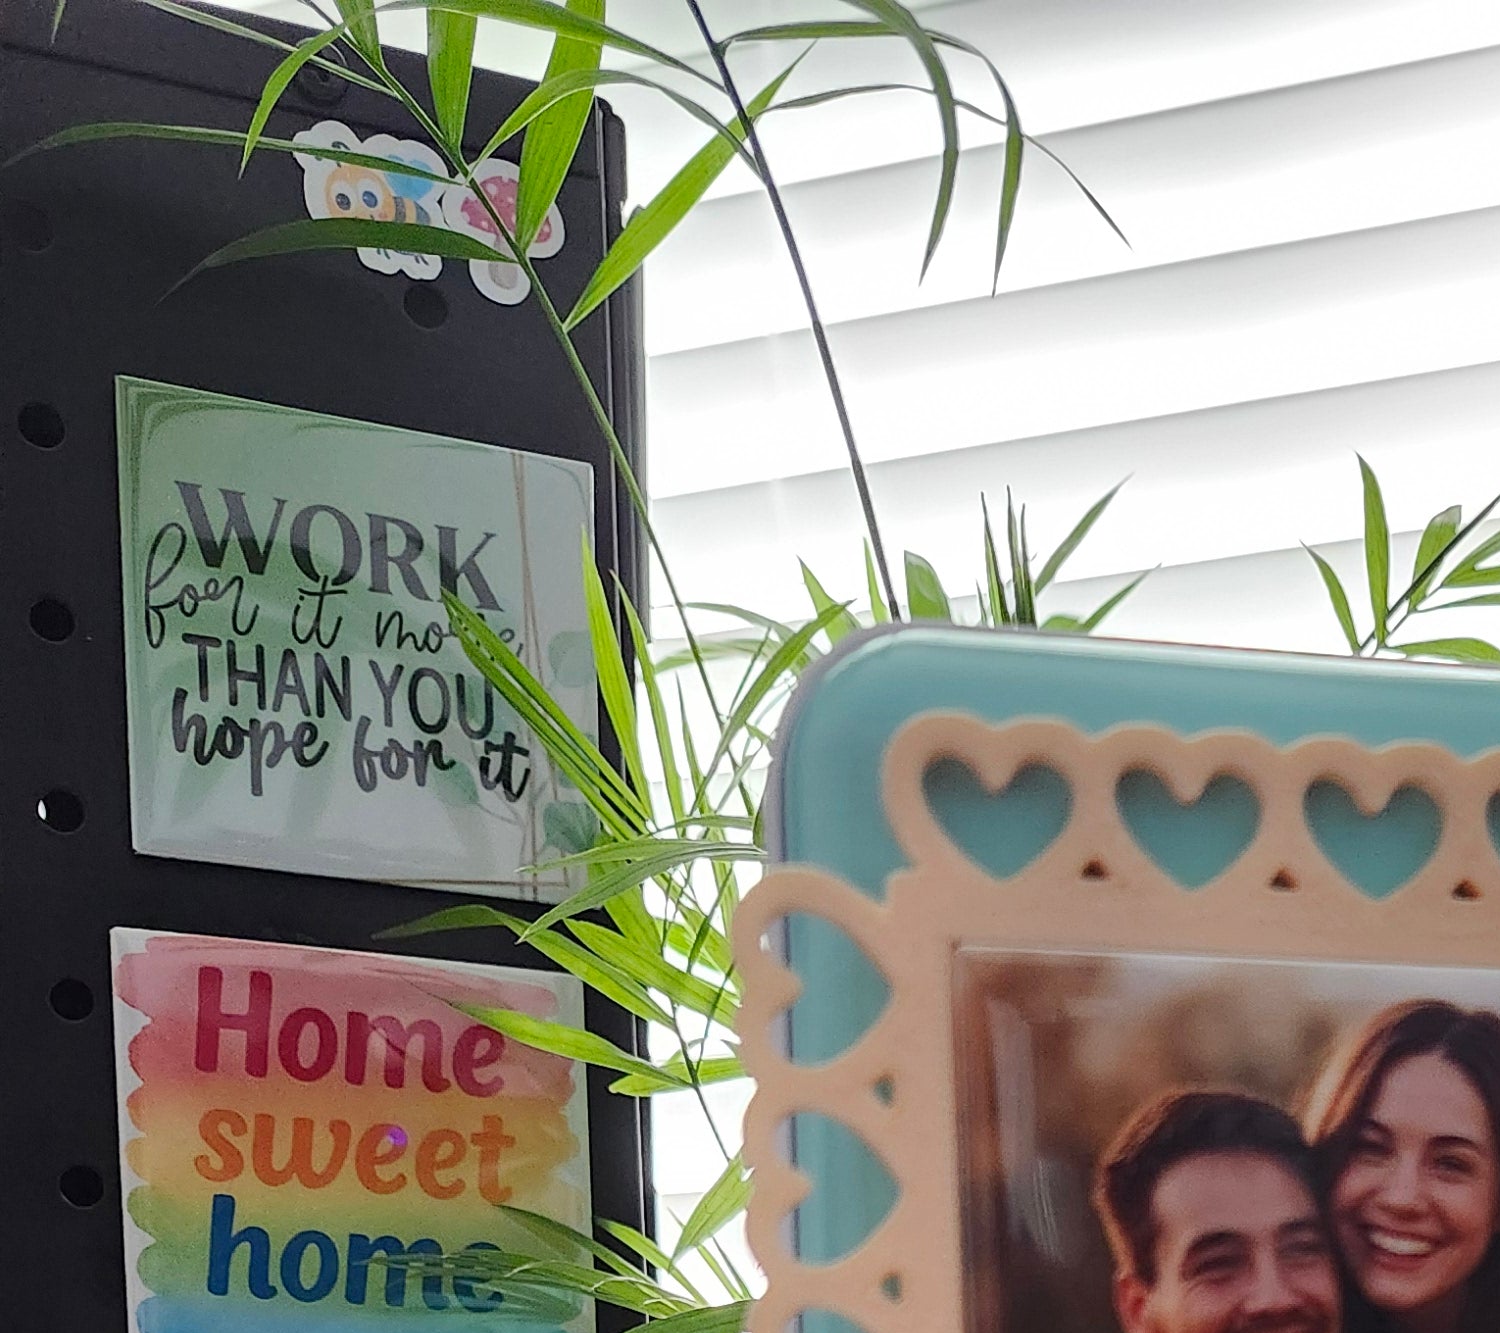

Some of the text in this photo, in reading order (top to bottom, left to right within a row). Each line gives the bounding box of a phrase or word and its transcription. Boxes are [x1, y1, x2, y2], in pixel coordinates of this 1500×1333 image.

[145, 522, 259, 649] for
[291, 574, 348, 649] it
[175, 480, 504, 612] WORK
[171, 687, 531, 802] hope for it
[182, 632, 496, 740] THAN YOU
[193, 966, 506, 1098] Home
[193, 1108, 517, 1206] sweet
[206, 1193, 506, 1314] home
